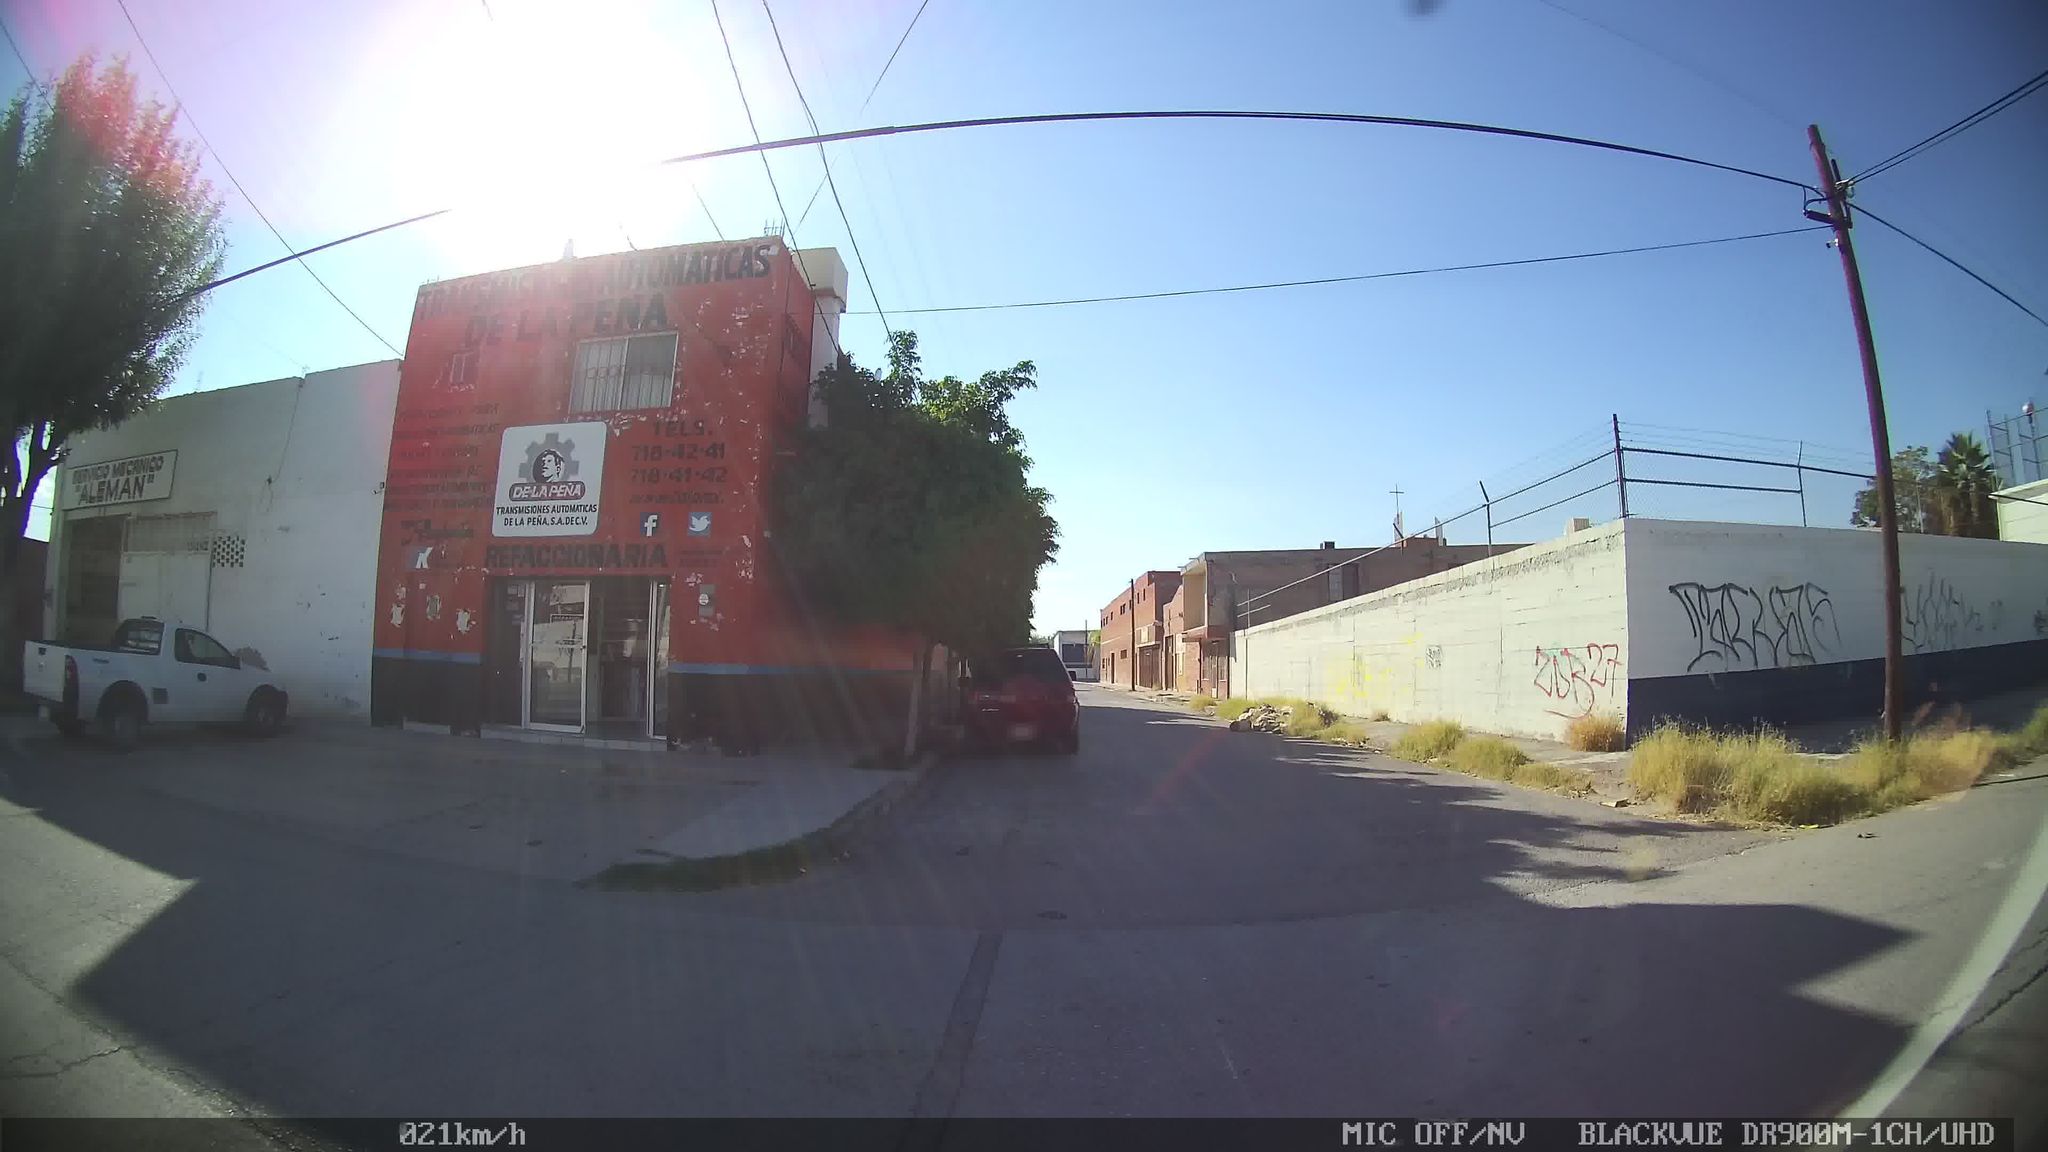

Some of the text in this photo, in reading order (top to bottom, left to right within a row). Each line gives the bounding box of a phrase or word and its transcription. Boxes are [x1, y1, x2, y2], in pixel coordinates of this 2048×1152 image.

[496, 505, 550, 515] TRANSMISIONES
[551, 504, 597, 513] AUTOMATICAS
[504, 518, 513, 526] DE
[515, 517, 524, 526] LA
